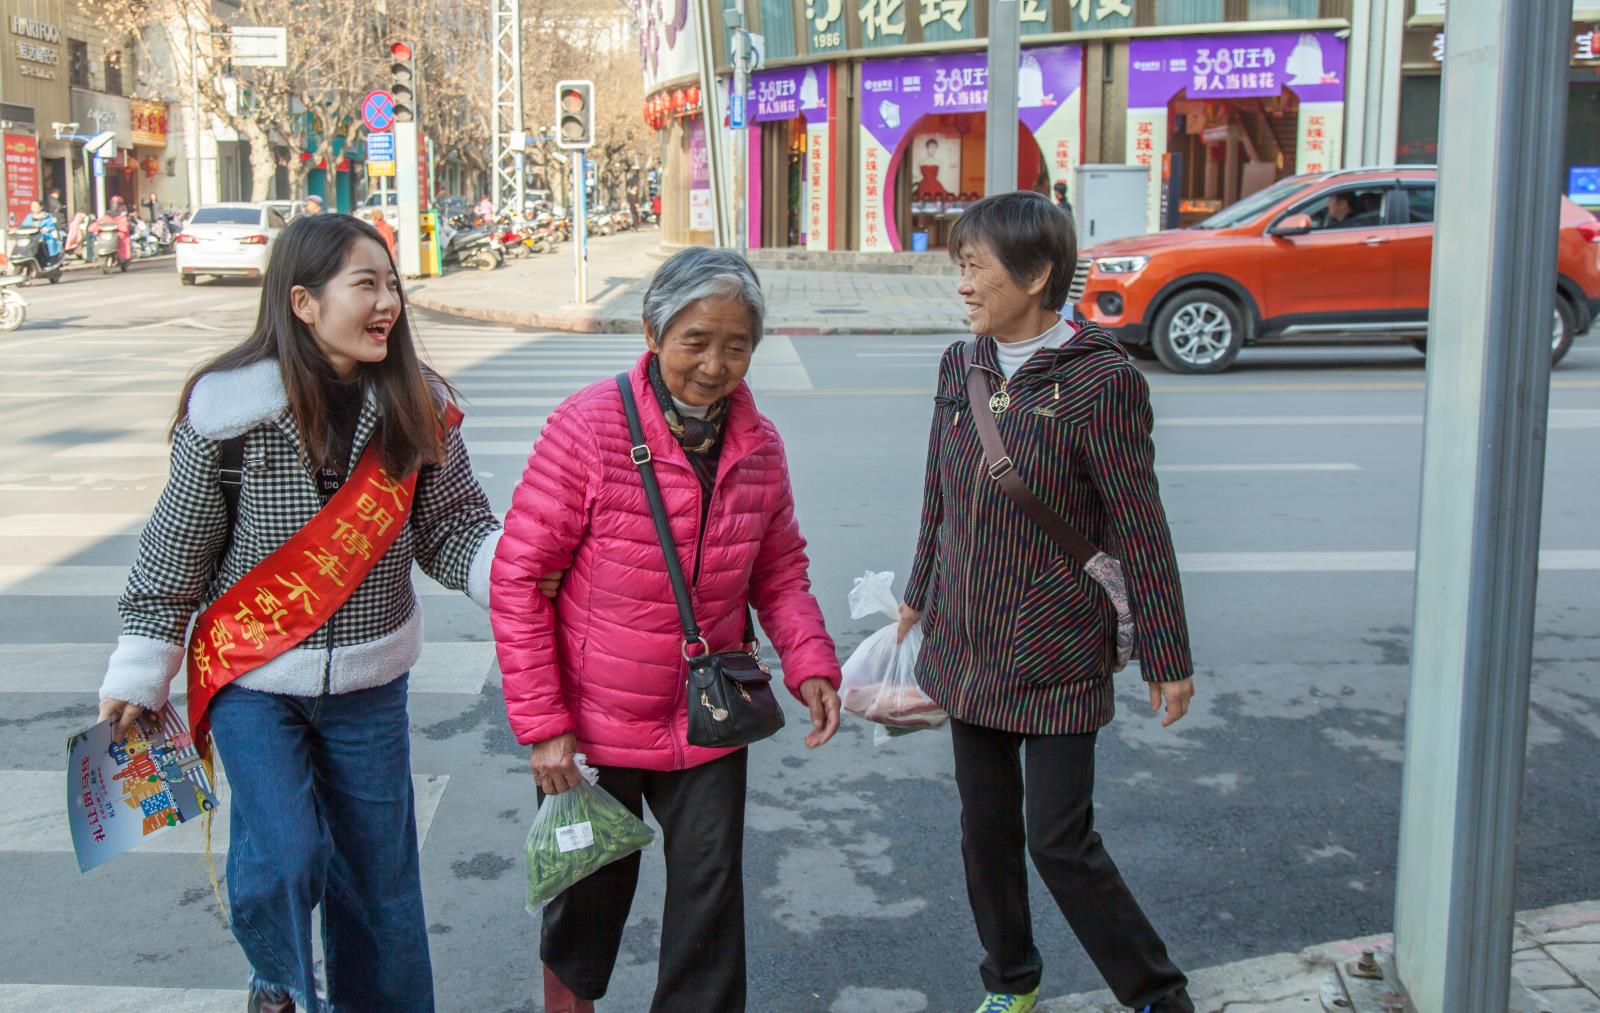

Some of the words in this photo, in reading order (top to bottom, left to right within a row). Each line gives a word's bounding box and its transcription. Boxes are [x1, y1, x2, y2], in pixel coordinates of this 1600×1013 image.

[813, 32, 840, 48] 1986
[1193, 72, 1275, 91] 男人当钱花
[865, 147, 878, 247] 买珠宝第二件半价
